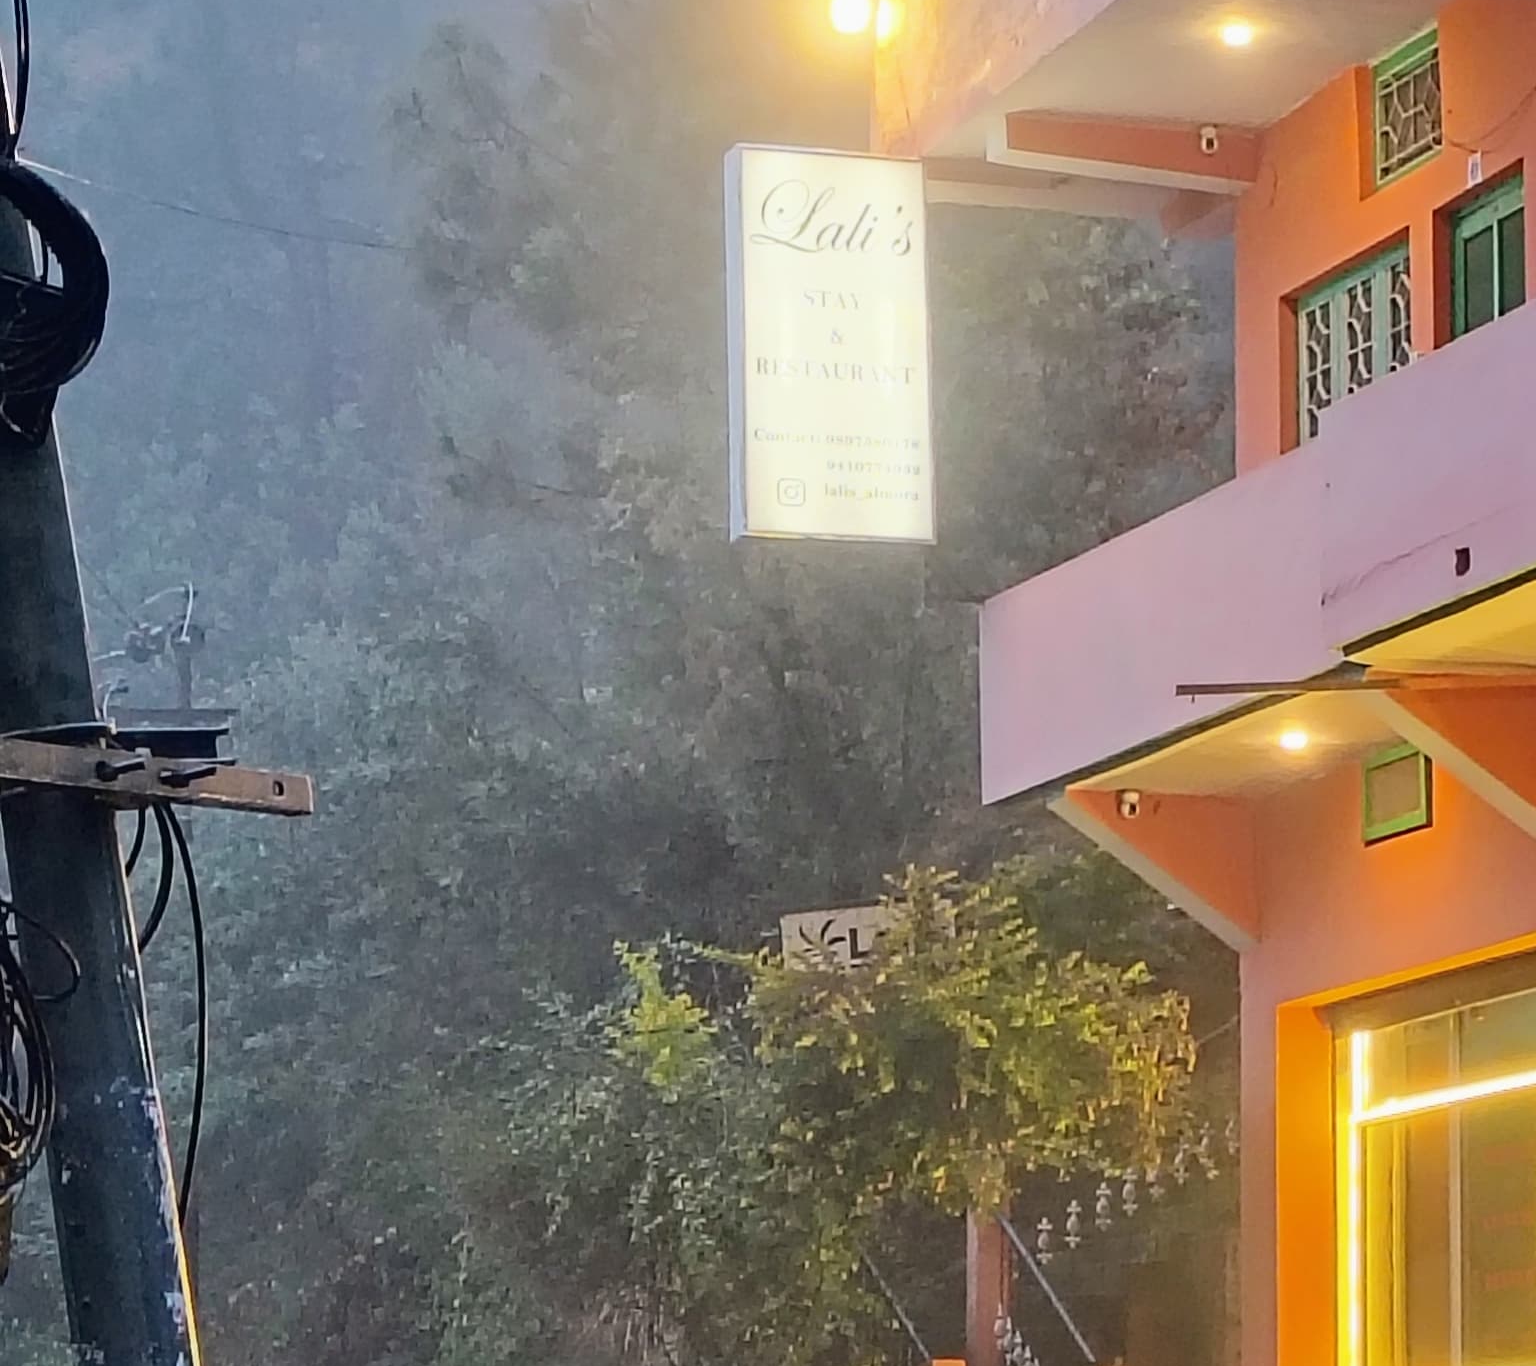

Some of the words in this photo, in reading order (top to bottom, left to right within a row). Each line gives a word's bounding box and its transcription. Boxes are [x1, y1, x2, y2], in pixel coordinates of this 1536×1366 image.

[750, 179, 914, 256] Lali's
[803, 290, 864, 311] STAY
[830, 327, 845, 346] &
[756, 357, 916, 386] RESTAURANT
